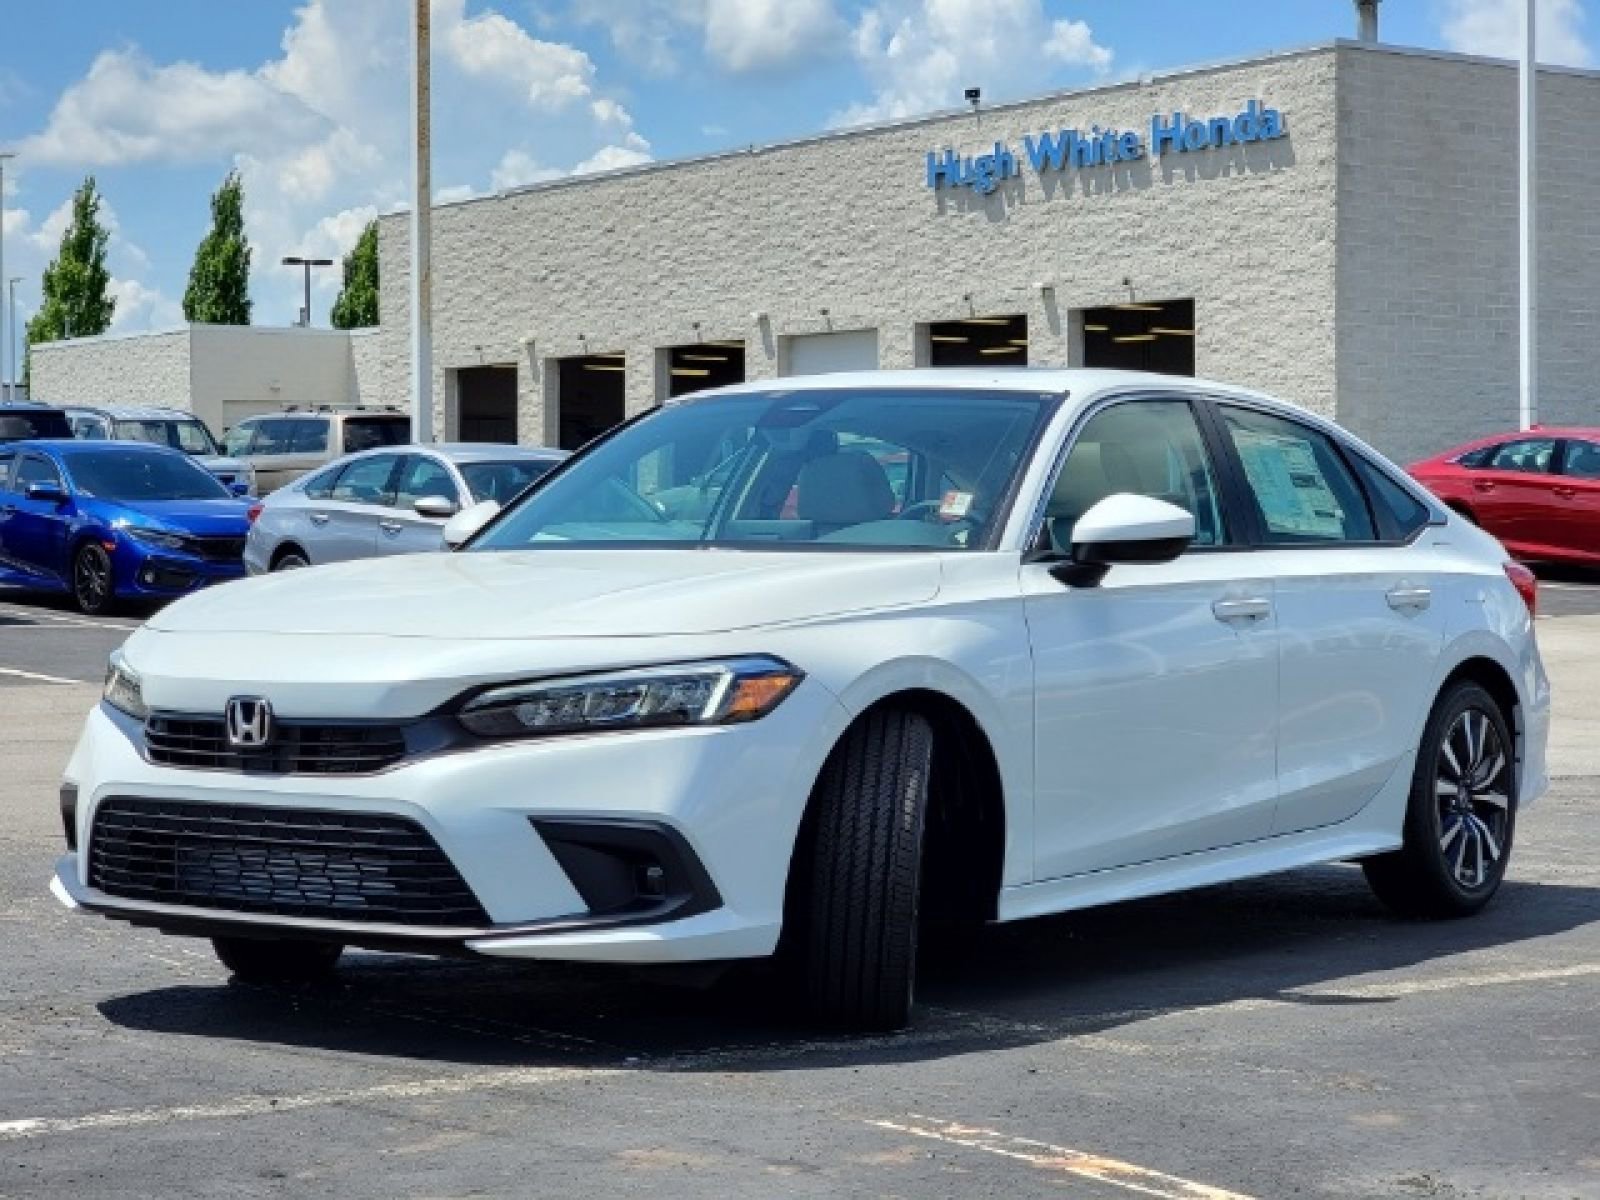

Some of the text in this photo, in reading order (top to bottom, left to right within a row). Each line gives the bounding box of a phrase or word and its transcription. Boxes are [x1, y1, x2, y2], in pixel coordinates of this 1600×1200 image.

[926, 99, 1284, 194] Hugh White Honda
